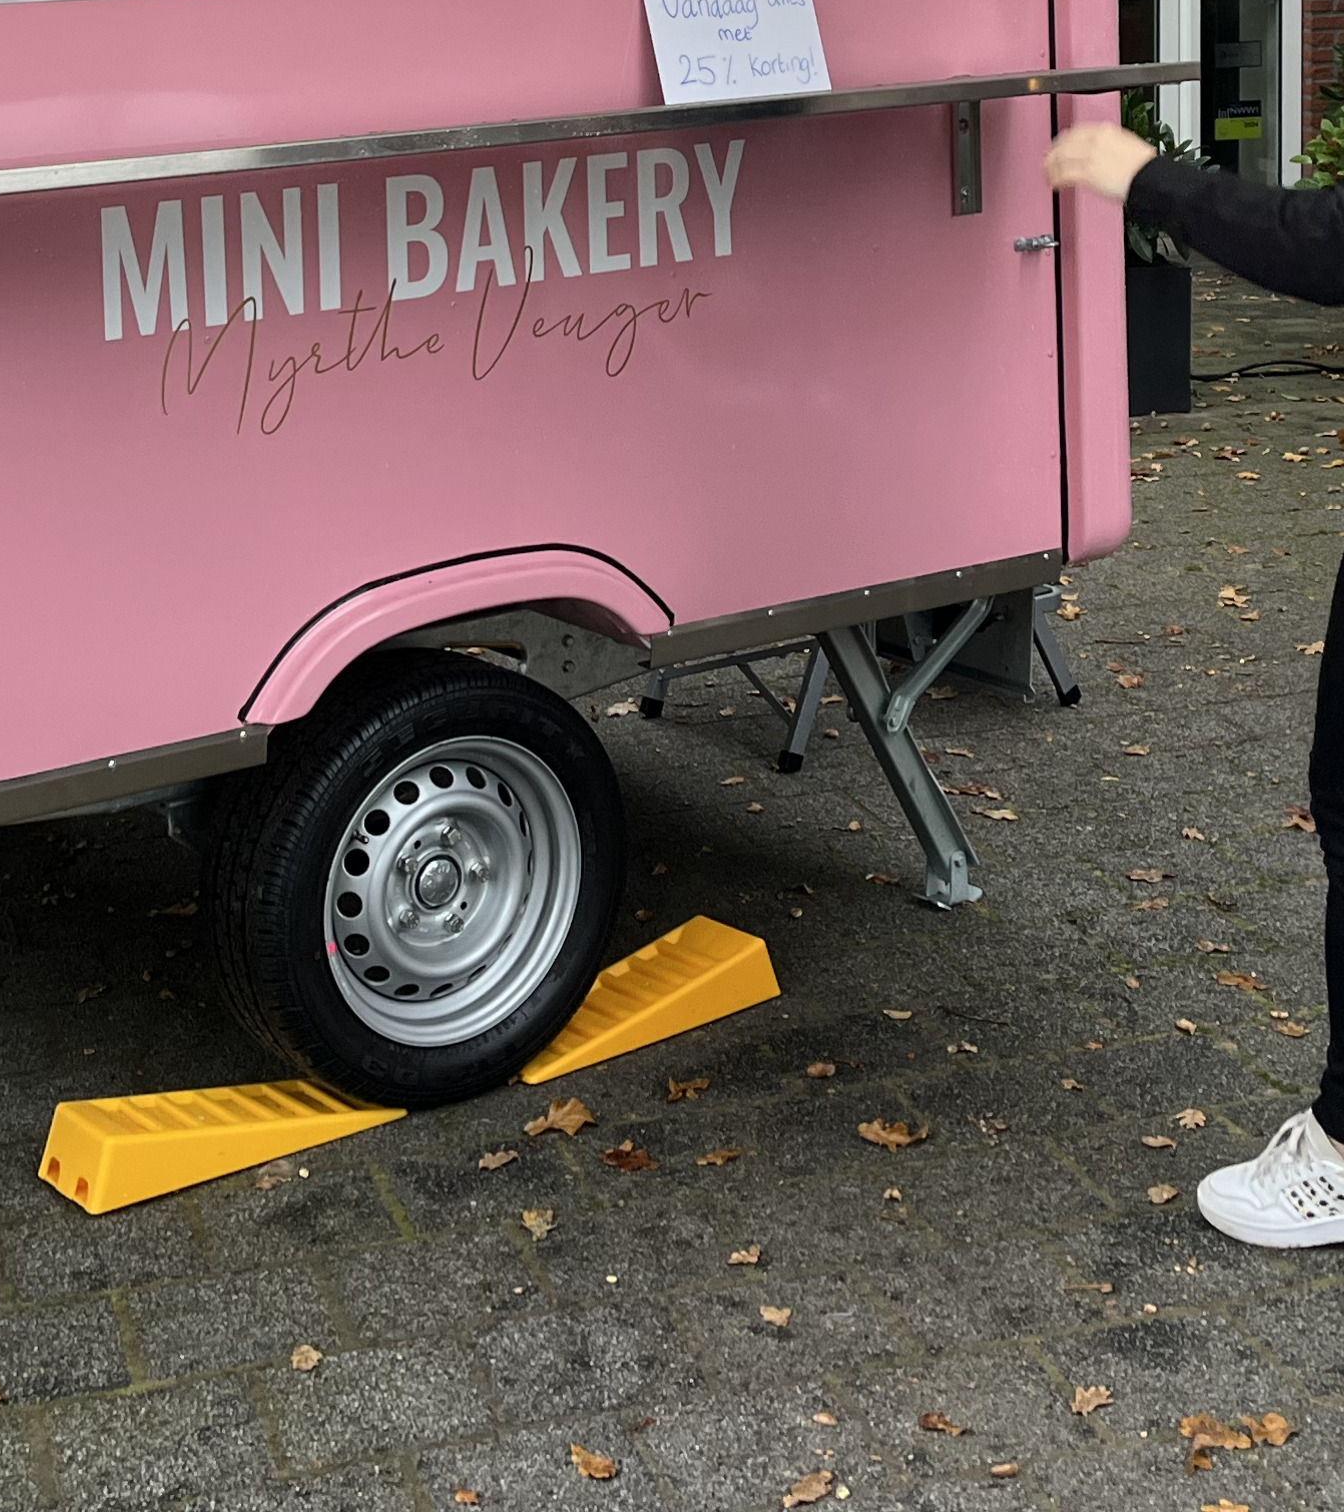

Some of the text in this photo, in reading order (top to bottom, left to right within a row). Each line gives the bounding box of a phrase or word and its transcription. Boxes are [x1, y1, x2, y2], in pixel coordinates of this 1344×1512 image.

[717, 27, 753, 42] met
[101, 139, 746, 341] MINI BAKERY
[162, 245, 713, 436] Myrthe Veuger
